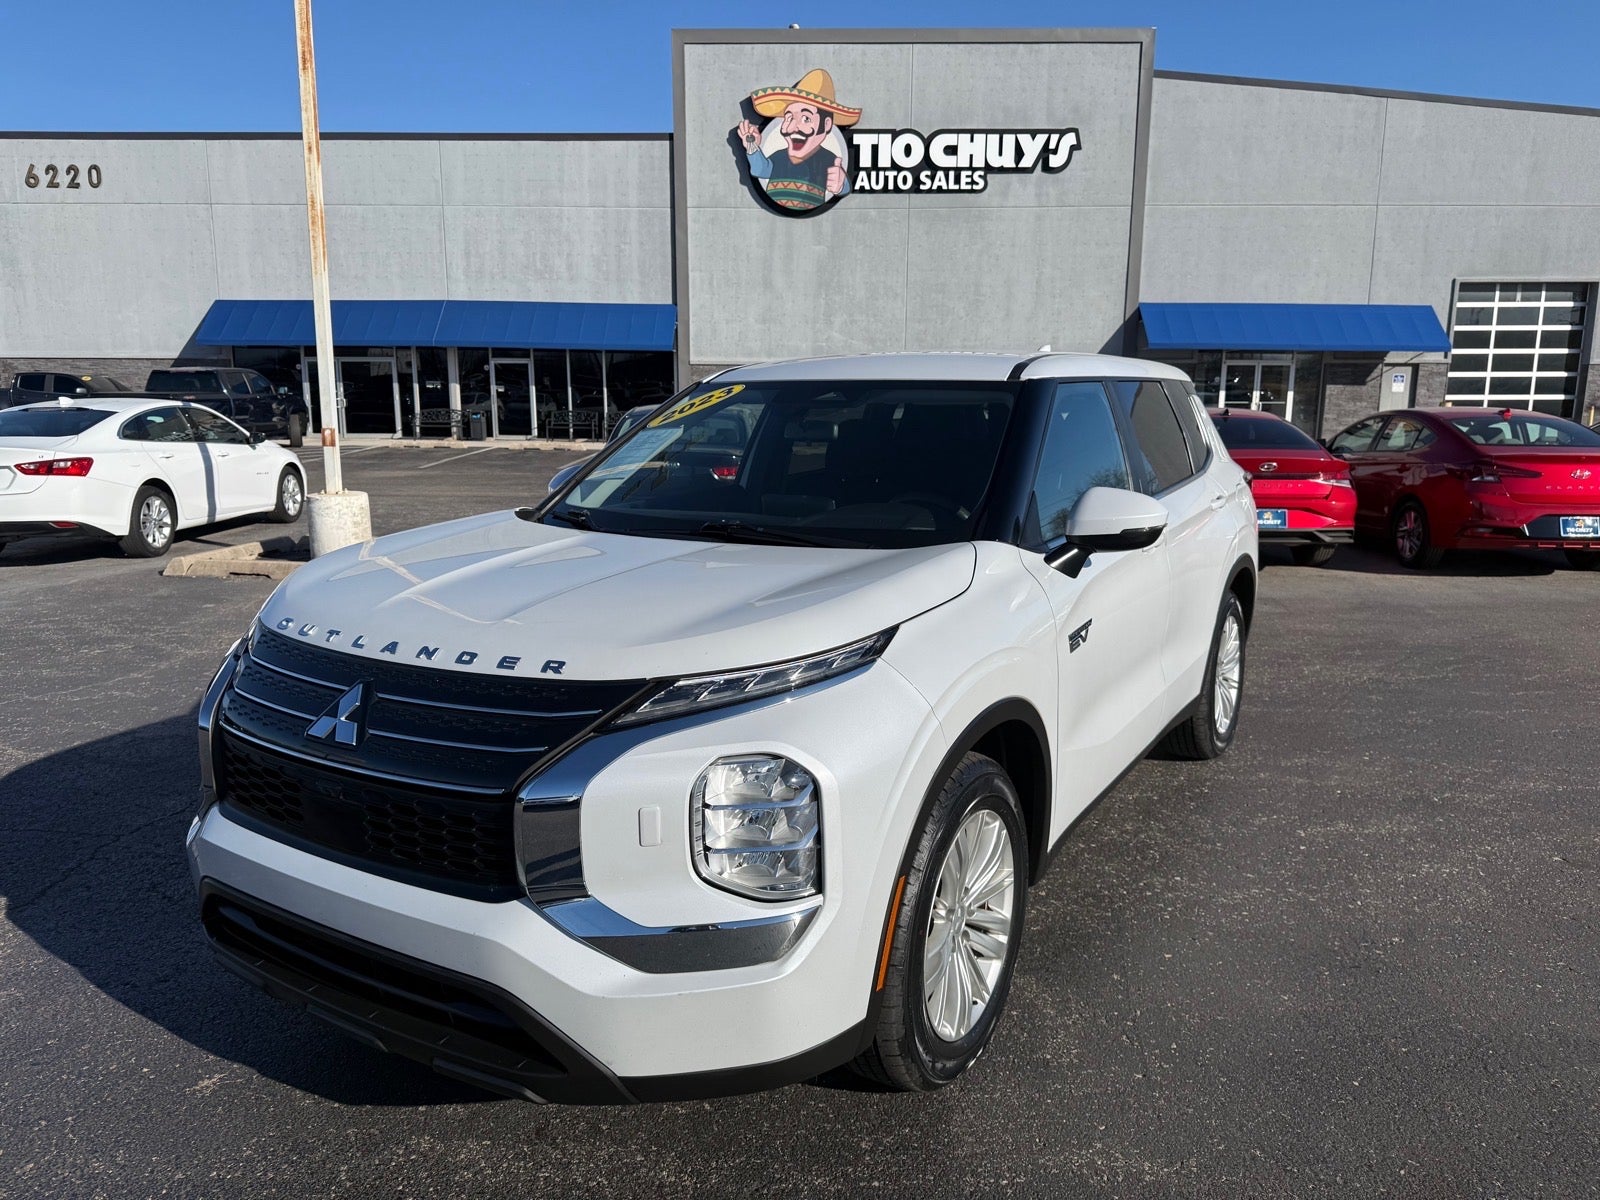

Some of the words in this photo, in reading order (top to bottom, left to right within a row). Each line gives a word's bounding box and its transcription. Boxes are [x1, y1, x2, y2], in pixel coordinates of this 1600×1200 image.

[852, 133, 924, 168] TIO
[929, 131, 1077, 168] CHUY'S
[25, 163, 102, 189] 6220
[854, 170, 913, 190] AUTO
[919, 170, 985, 190] SALES
[657, 387, 735, 425] 2023
[276, 617, 567, 675] OUTLANDER
